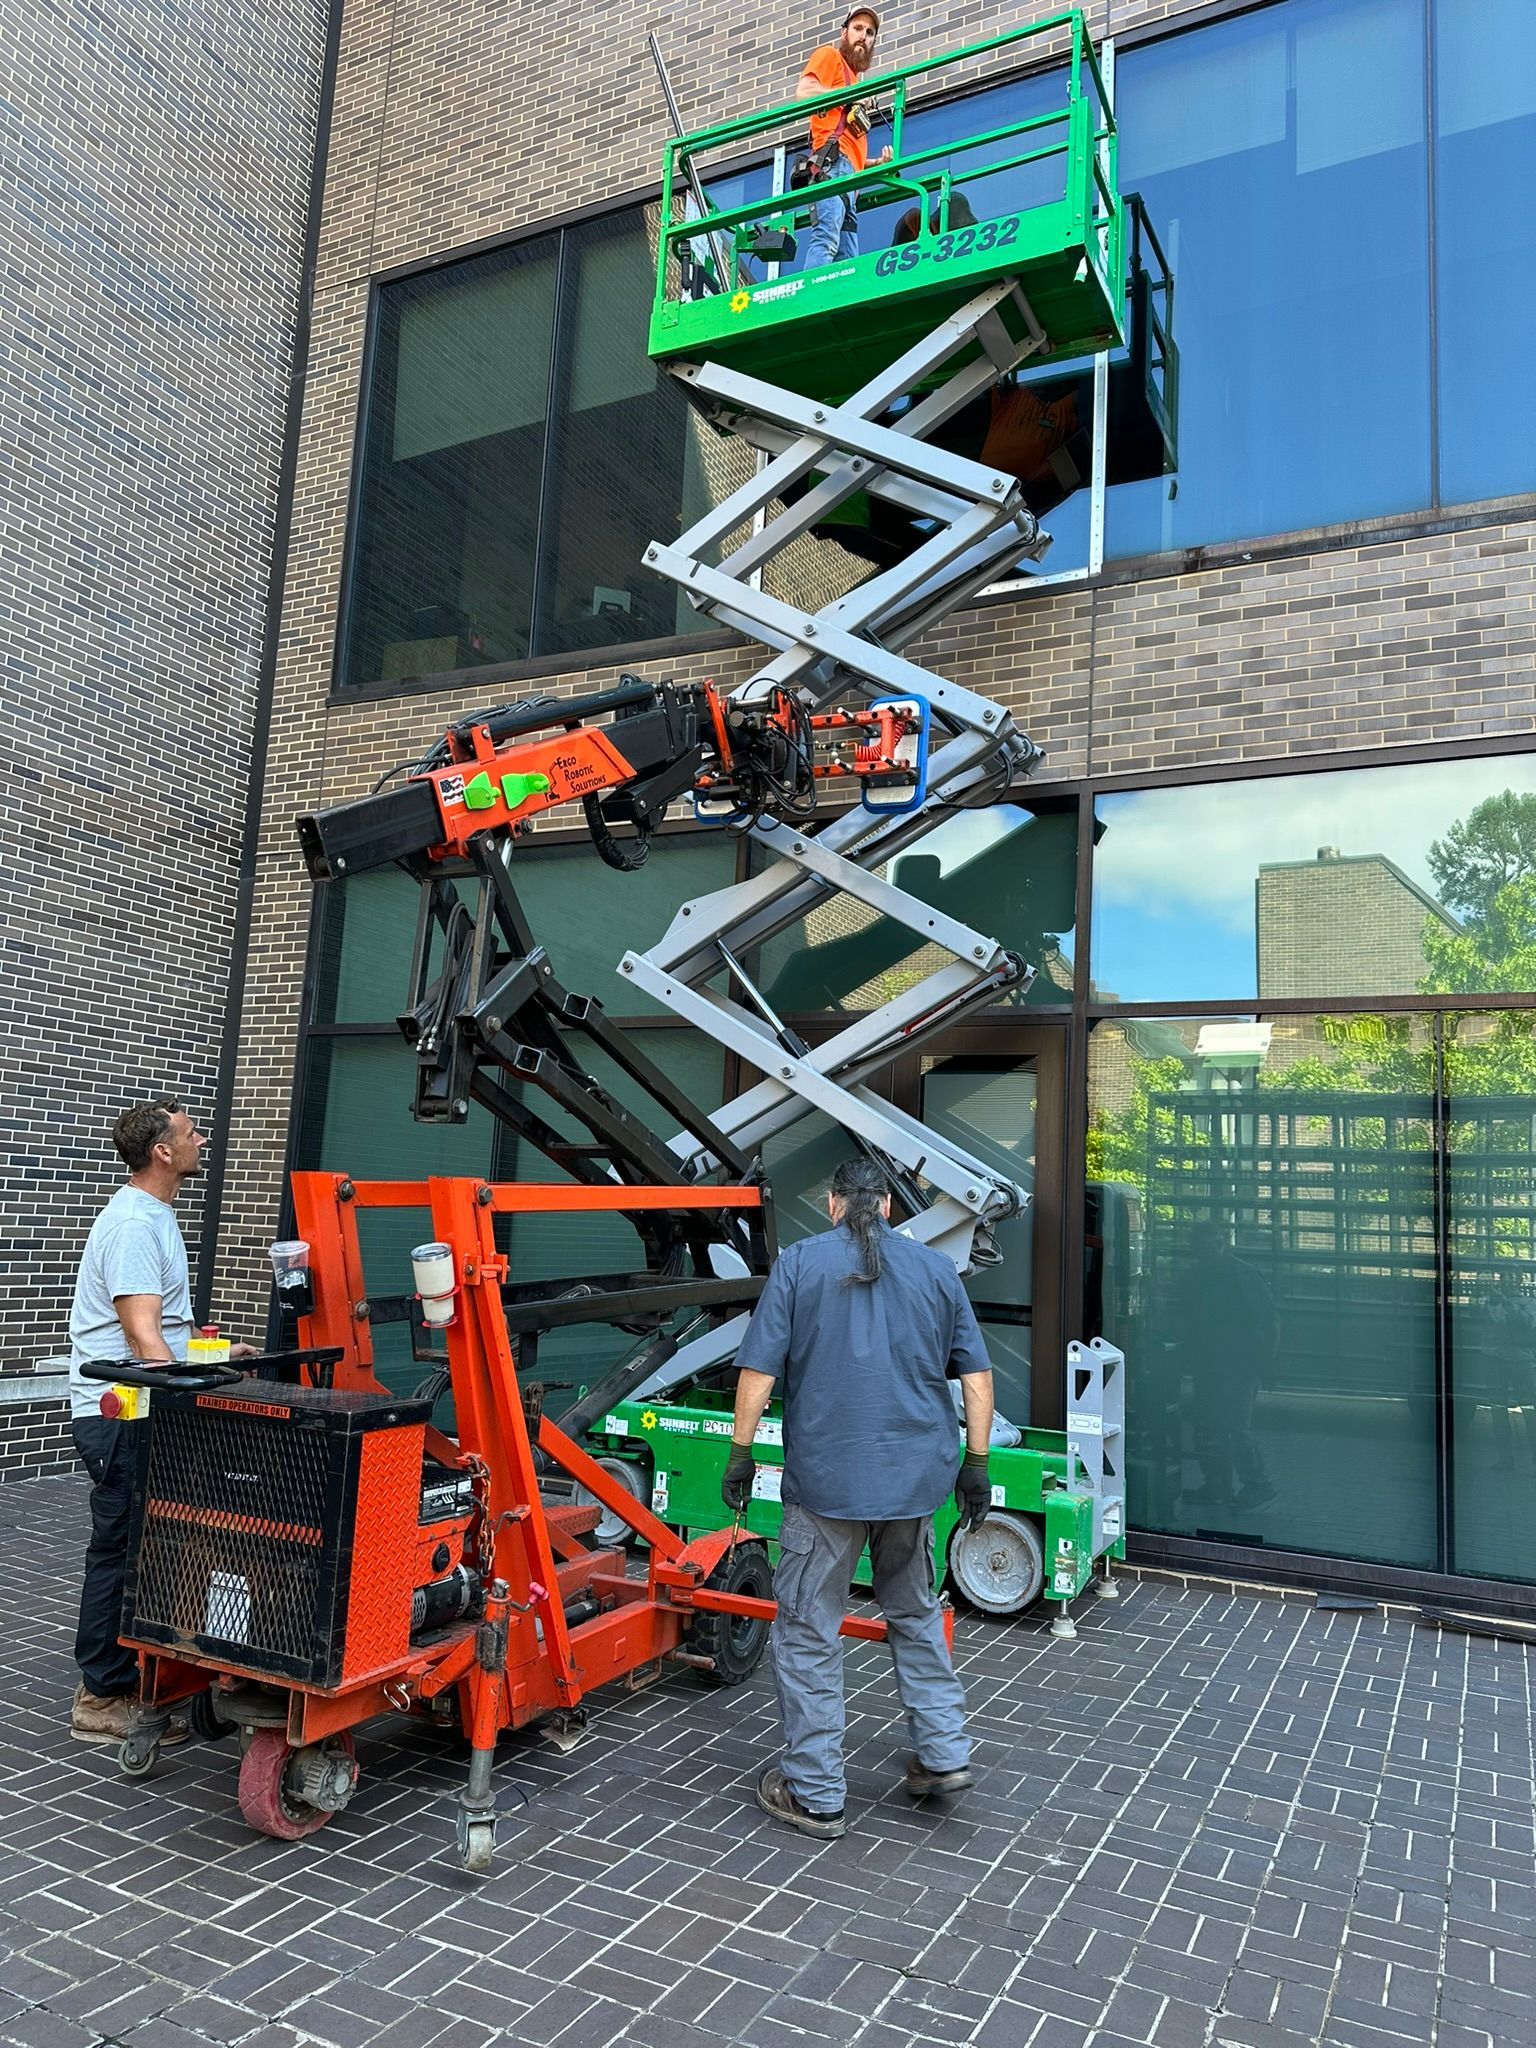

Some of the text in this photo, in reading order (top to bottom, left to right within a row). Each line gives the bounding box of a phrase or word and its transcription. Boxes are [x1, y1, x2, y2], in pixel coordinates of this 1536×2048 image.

[875, 217, 1020, 277] GS-3232
[752, 279, 805, 303] SUNBELT
[556, 756, 577, 770] ERGO
[564, 765, 594, 782] ROBOTIC
[570, 774, 607, 794] SOLUTIONS
[198, 1396, 289, 1418] TRAINED OPERATORS ONLY
[659, 1417, 700, 1431] SUNBELT
